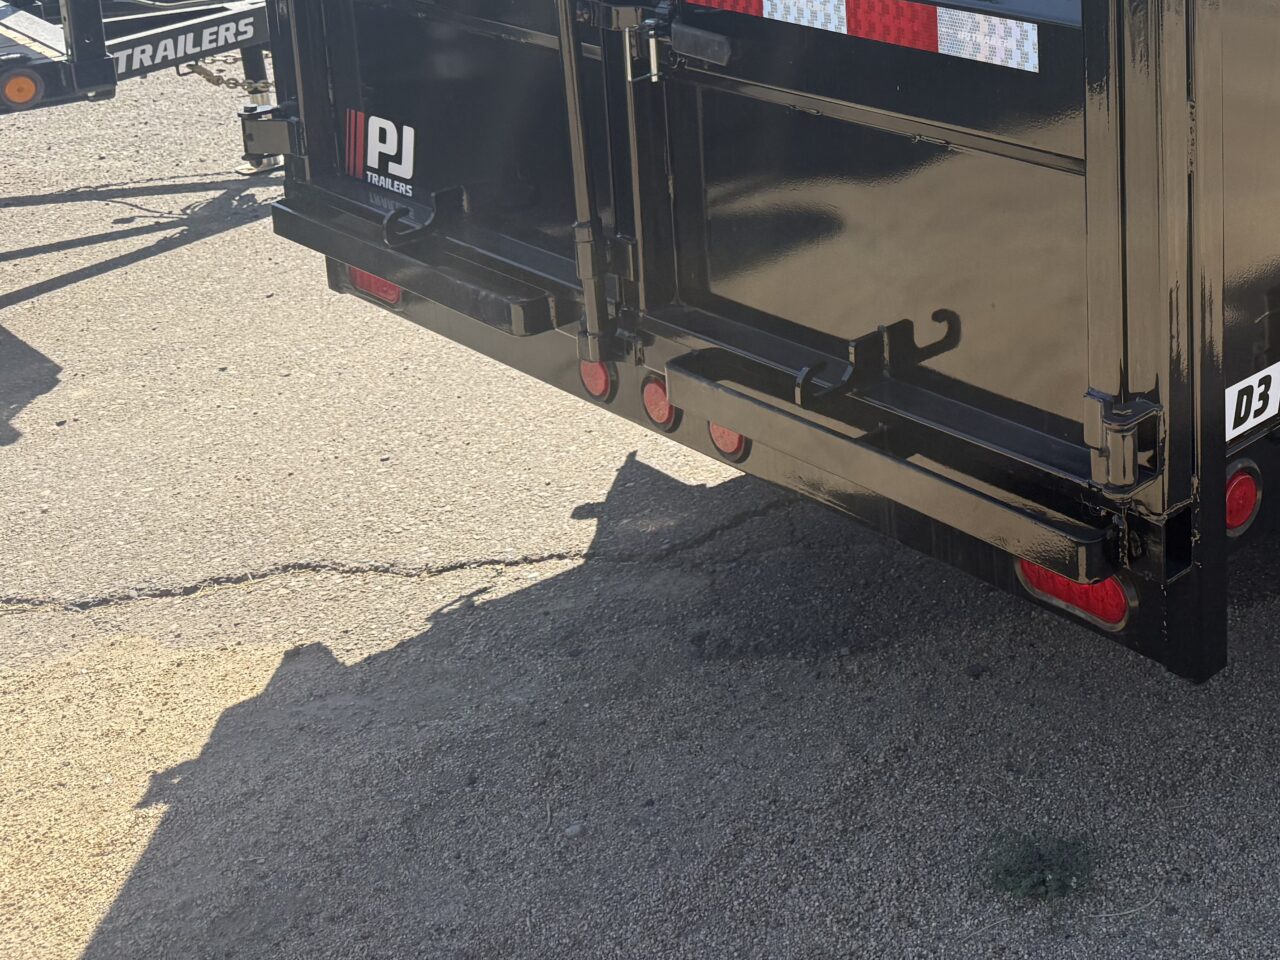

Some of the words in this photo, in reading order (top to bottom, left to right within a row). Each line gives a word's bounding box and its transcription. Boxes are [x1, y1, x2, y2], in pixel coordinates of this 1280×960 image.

[113, 16, 254, 74] TRAILERS
[367, 115, 414, 180] PJ
[366, 171, 413, 197] TRAILERS
[1232, 374, 1272, 431] D3
